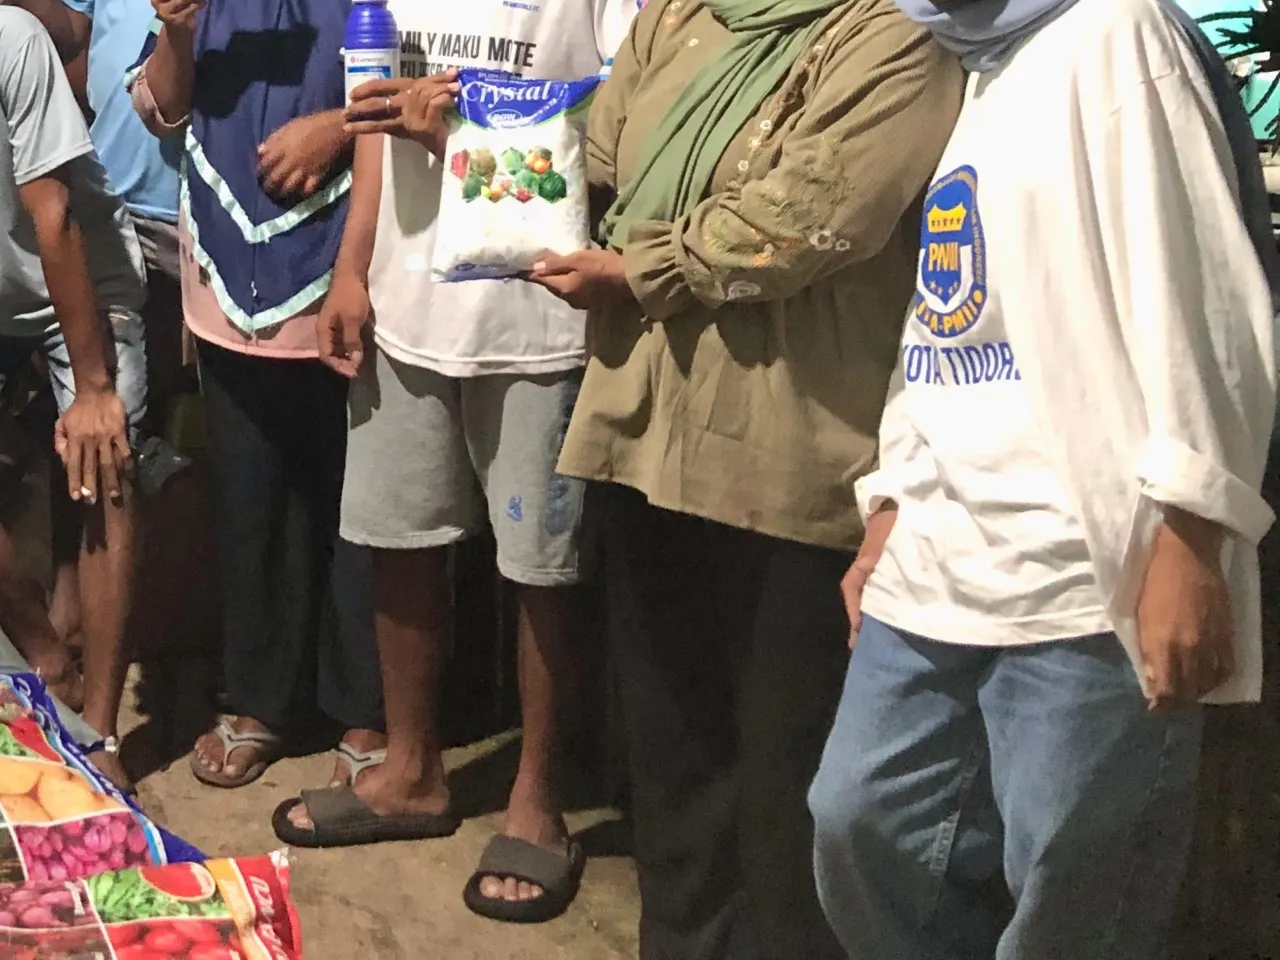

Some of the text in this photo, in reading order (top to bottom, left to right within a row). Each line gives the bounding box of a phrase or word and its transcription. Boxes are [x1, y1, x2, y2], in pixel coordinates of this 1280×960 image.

[438, 33, 481, 59] MAKU
[463, 81, 552, 108] Crystal
[927, 242, 959, 272] PMII
[904, 342, 1022, 386] OTA TIDOR
